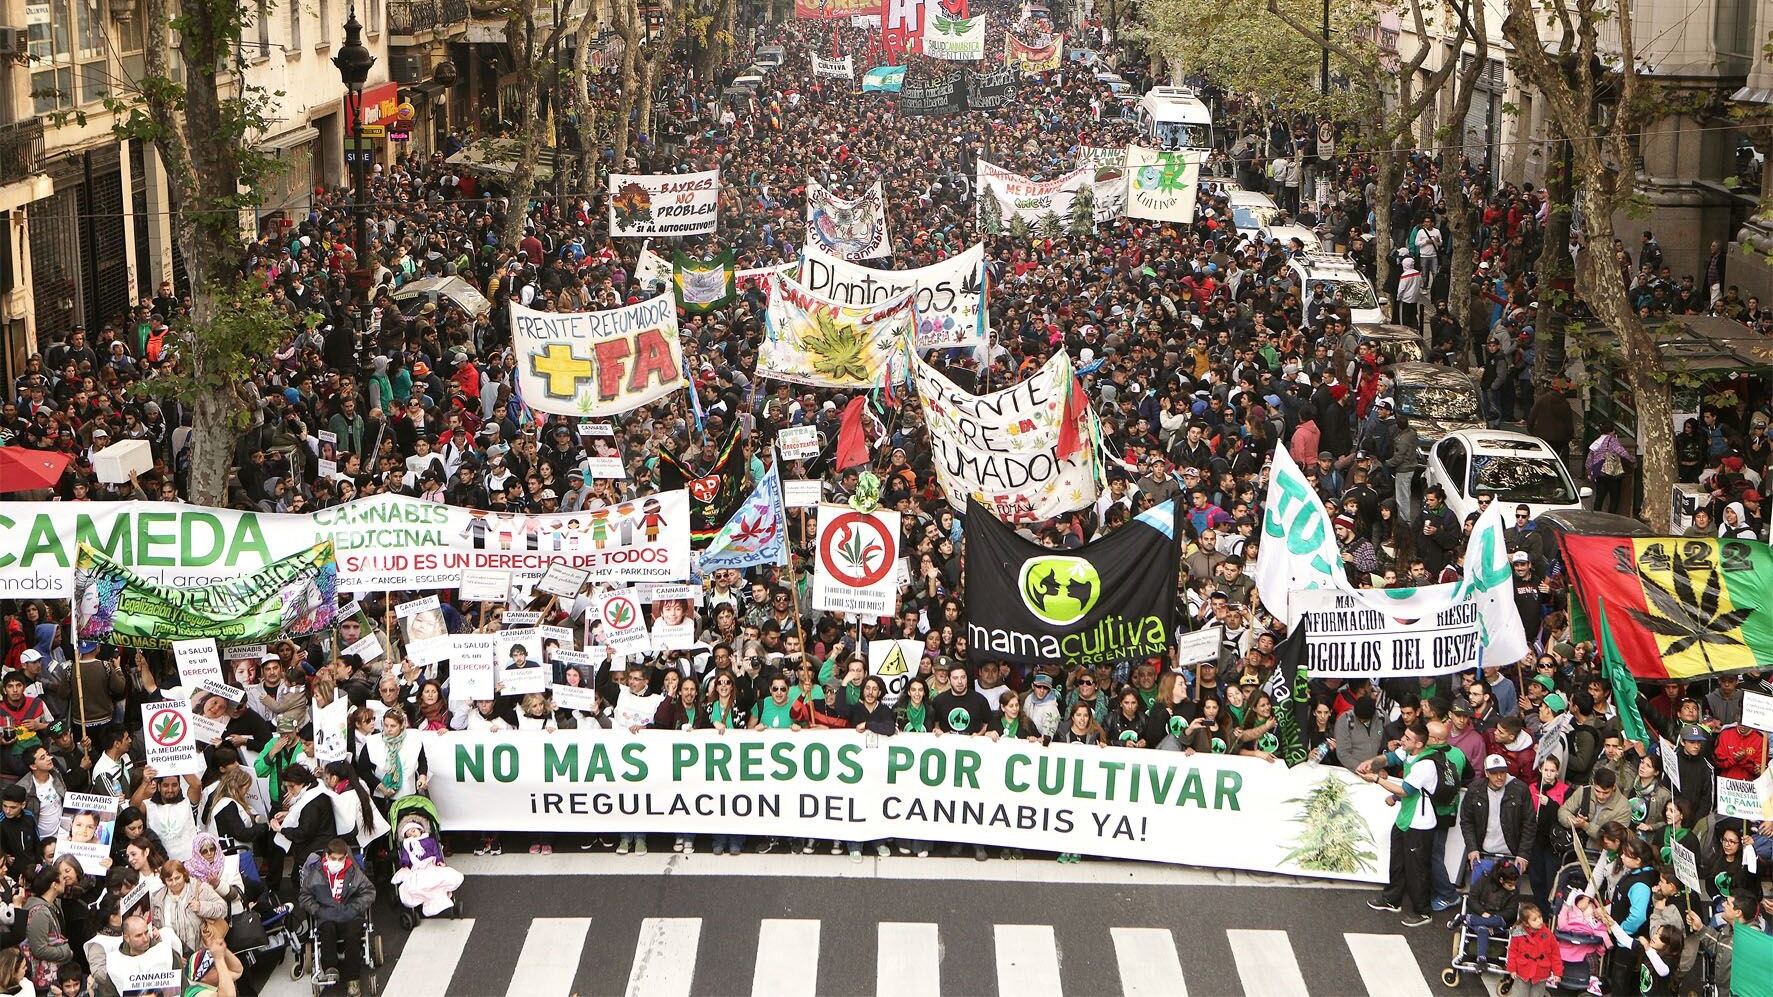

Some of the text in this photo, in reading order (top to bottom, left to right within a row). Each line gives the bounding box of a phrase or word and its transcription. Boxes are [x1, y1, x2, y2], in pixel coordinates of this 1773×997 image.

[818, 62, 846, 71] CULTIVA
[660, 178, 713, 194] BAYRES
[1006, 183, 1022, 195] ME
[675, 192, 695, 205] NO
[657, 202, 717, 218] PROBLEM
[517, 316, 585, 340] FRENTE
[958, 417, 1008, 453] RE
[312, 502, 449, 526] CANNABIS
[314, 528, 450, 551] MEDICINAL
[346, 554, 409, 573] SALUD
[414, 553, 438, 570] ES
[443, 553, 470, 569] UN
[573, 553, 596, 569] DE
[601, 548, 669, 565] TODOS
[370, 576, 407, 586] CANCER
[596, 568, 613, 576] HIV
[620, 568, 671, 577] PARKINSON
[656, 586, 690, 594] CANNABIS
[400, 597, 434, 611] CANNABIS
[1335, 595, 1355, 609] MAS
[500, 628, 536, 637] CANNABIS
[542, 625, 570, 635] CANNABIS
[615, 625, 646, 637] MEDICINA
[113, 631, 133, 646] NO
[132, 634, 158, 648] MAS
[452, 642, 463, 650] La
[188, 646, 213, 655] SALUD
[227, 646, 263, 655] CANNABIS
[555, 649, 589, 660] CANNABIS
[1391, 637, 1425, 672] DEL
[1432, 630, 1479, 669] OESTE
[182, 667, 218, 677] DERECHO
[203, 678, 240, 696] CANNABIS
[145, 699, 187, 711] CANNABIS
[147, 744, 196, 755] LA MEDICINA
[151, 753, 193, 764] PROHIBIDA
[455, 742, 1244, 812] NO MAS PRESOS POR CULTIVAR
[69, 793, 113, 805] CANNABIS
[529, 793, 1148, 842] ¡REGULACION DEL CANNABIS YA!
[123, 880, 146, 905] CANNABIS
[129, 971, 175, 982] CANNABIS
